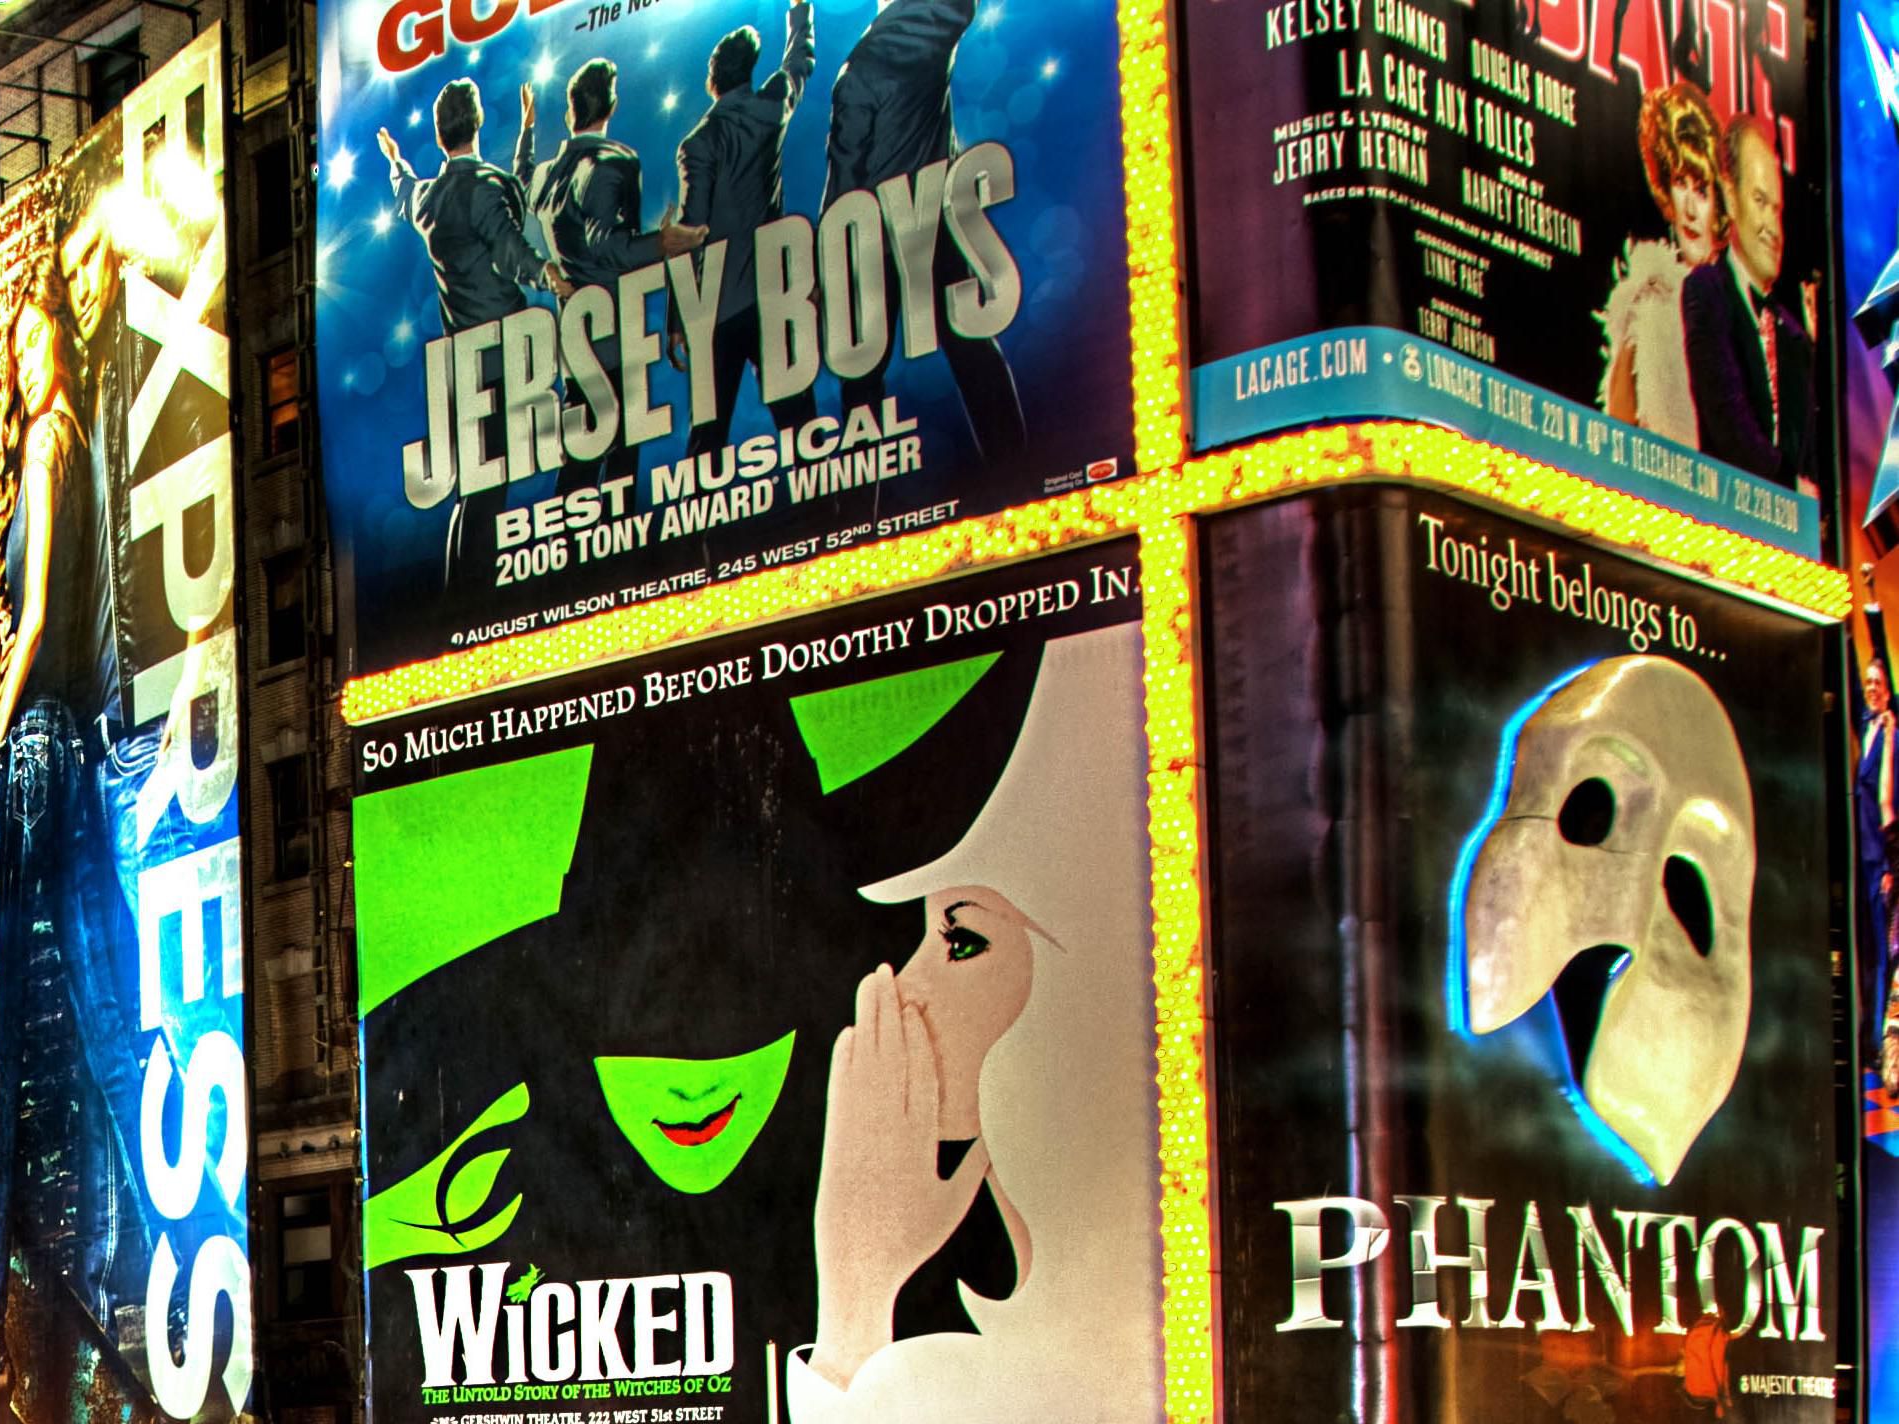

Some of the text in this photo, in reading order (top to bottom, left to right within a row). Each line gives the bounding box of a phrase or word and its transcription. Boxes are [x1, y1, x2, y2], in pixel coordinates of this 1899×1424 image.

[1266, 0, 1447, 62] KELSEY GRAMMER
[1470, 38, 1577, 128] DOUGLAS HODGE
[1272, 110, 1428, 145] MUSIC LYRICS BY
[1272, 130, 1429, 187] JERRY HERMAN
[1337, 48, 1535, 168] LA CAGE AUX FOLLES
[1462, 167, 1512, 224] HARVEY
[1516, 193, 1582, 256] FIERSTEIN
[403, 141, 1023, 508] JERSEY BOYS
[1235, 337, 1368, 401] LACAGE.COM
[495, 396, 918, 549] BEST MUSICAL
[495, 436, 922, 586] 2006 TONY WINNER
[466, 500, 960, 645] AUGUST WILSON THEATRE, 245 WEST STREET
[1418, 513, 1662, 652] Tonight belongs
[123, 20, 252, 1421] EXPRESS
[1273, 1194, 1827, 1342] PHANTOM
[675, 1406, 723, 1422] STREET
[1750, 1375, 1796, 1397] MAJESTIC
